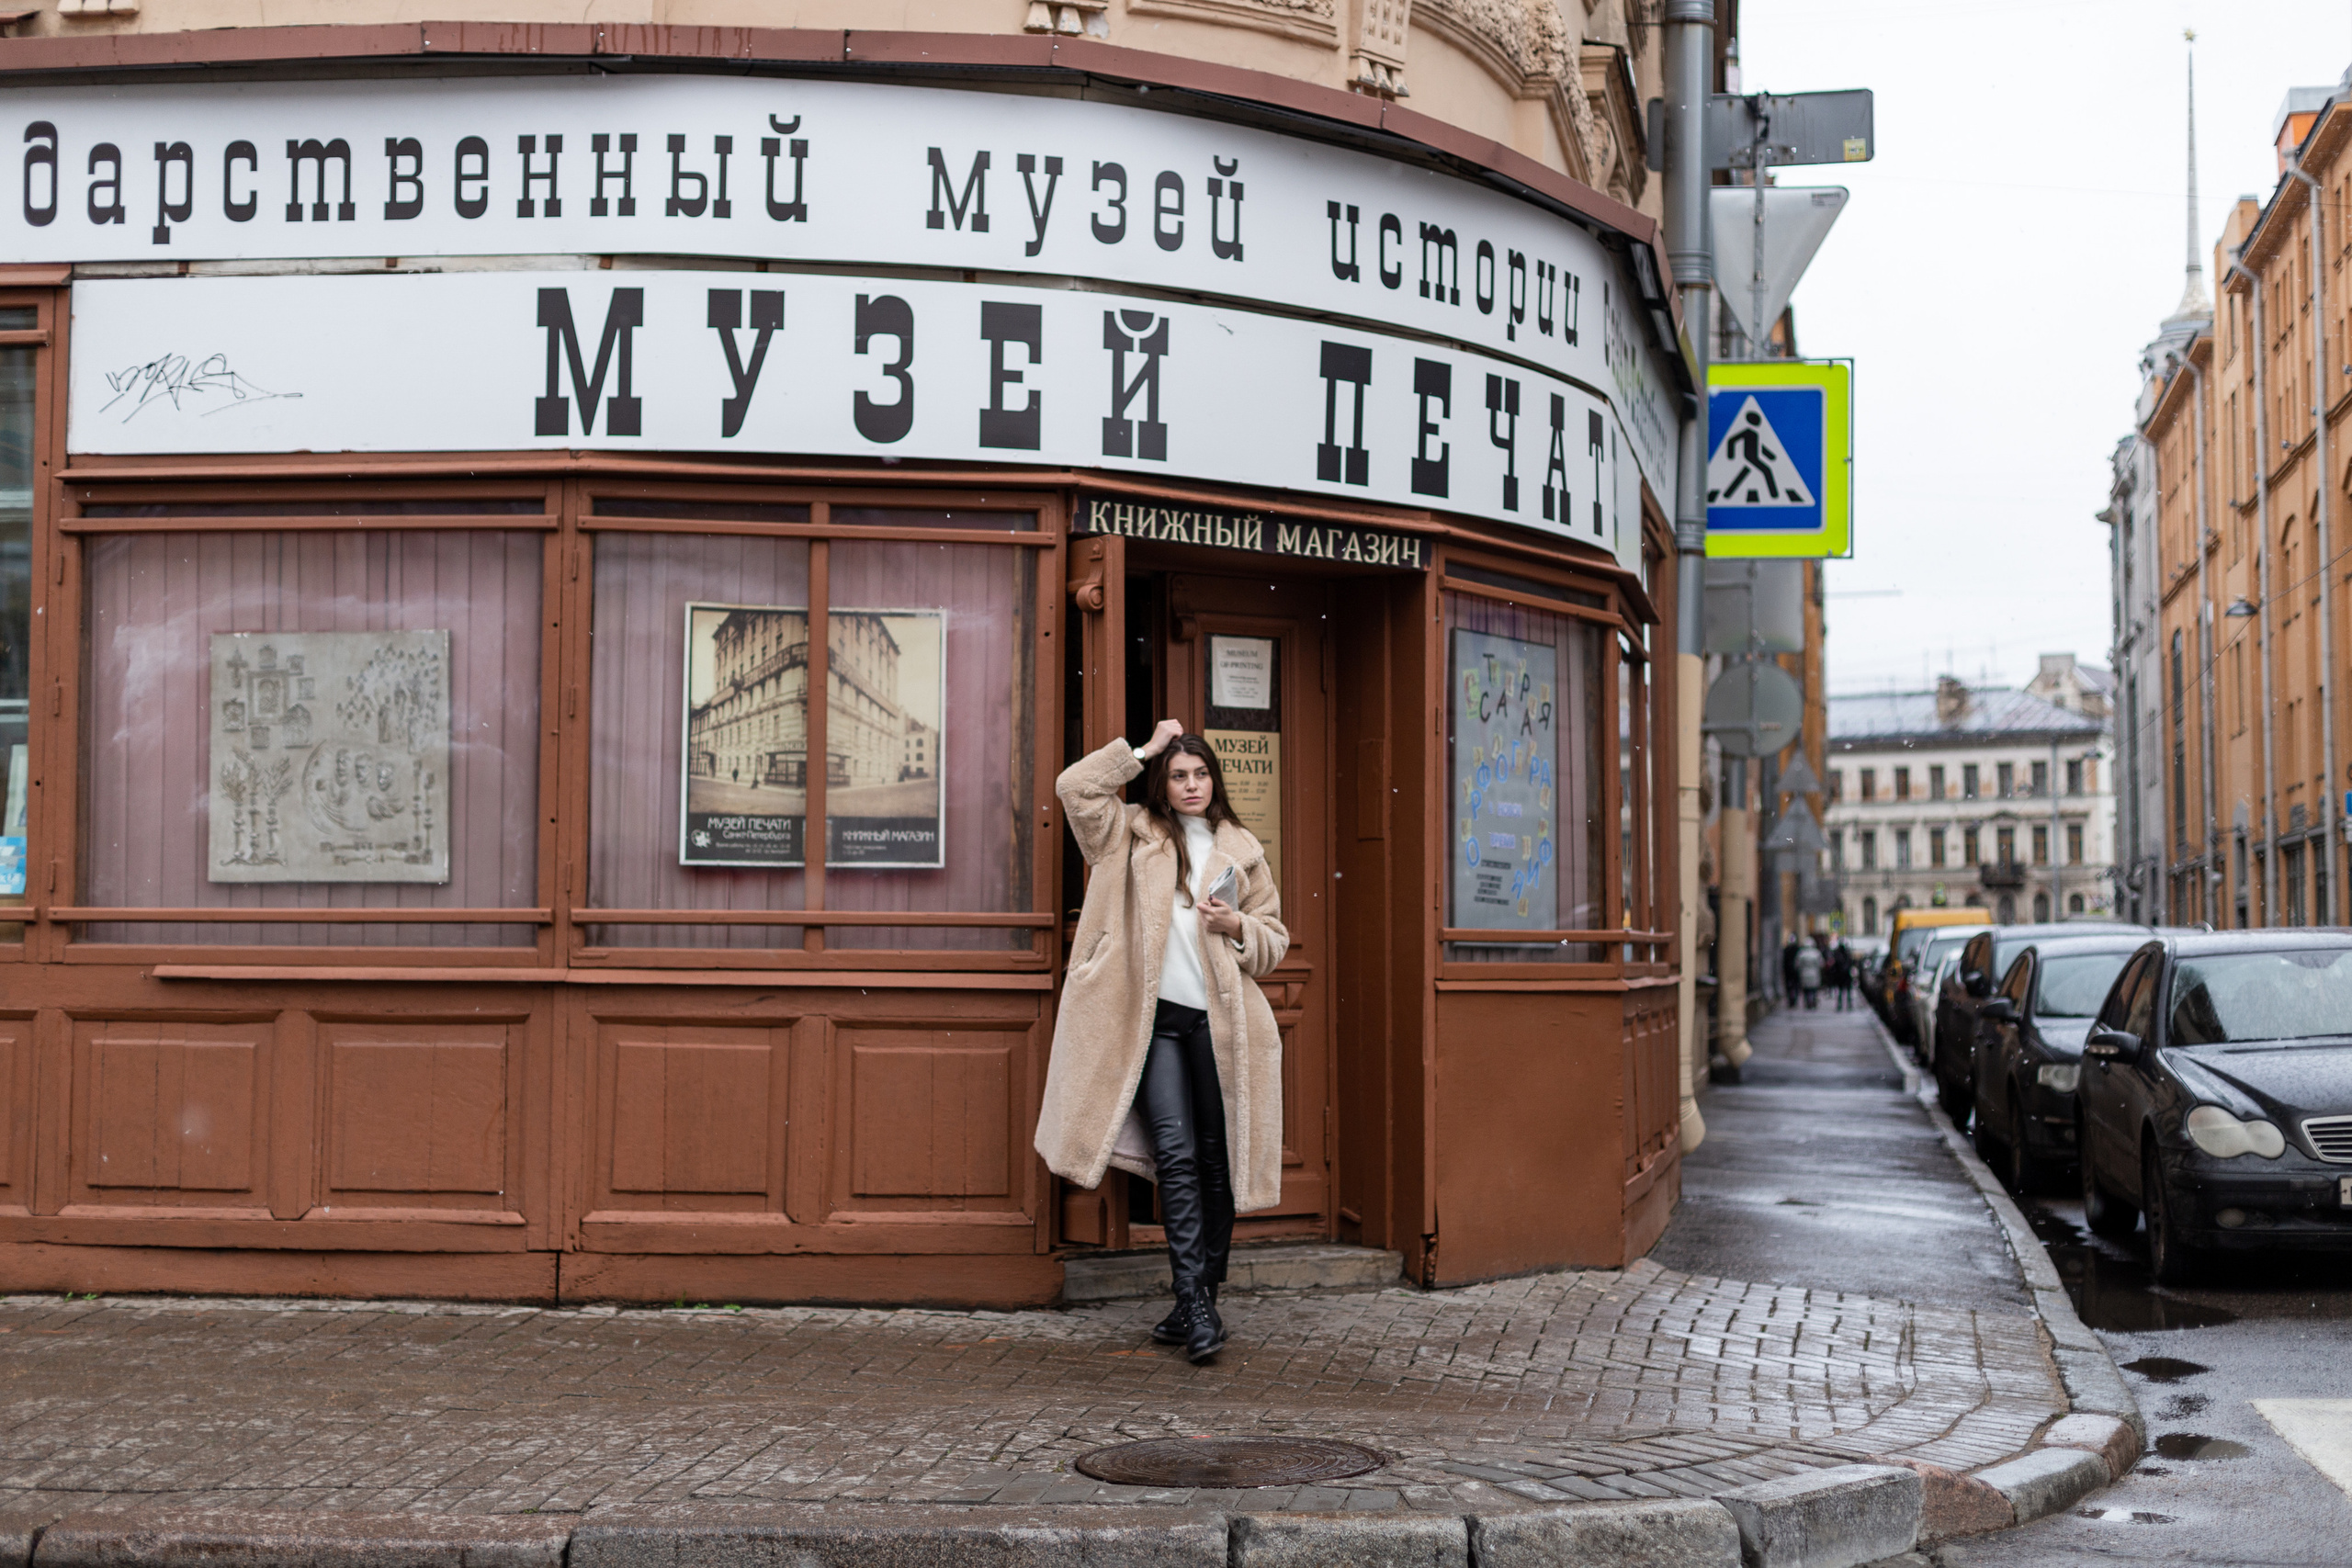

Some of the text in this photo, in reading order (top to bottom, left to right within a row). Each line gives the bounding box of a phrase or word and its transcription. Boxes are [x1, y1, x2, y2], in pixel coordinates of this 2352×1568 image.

[23, 114, 1580, 347] дарственный музей истории
[535, 287, 1170, 461] МУЗЕЙ
[1317, 340, 1619, 551] ПЕЧАТ
[1089, 501, 1420, 569] КНИЖНЫЙ МАГАЗИН
[1226, 649, 1258, 659] MUSEUM
[1219, 660, 1263, 671] OF PRINTING
[1215, 735, 1269, 754] МУЗЕЙ
[707, 816, 792, 831] МУЗЕЙ ПЕЧАТИ
[842, 829, 935, 842] КНИЖНЫЙ МАГАЗИН
